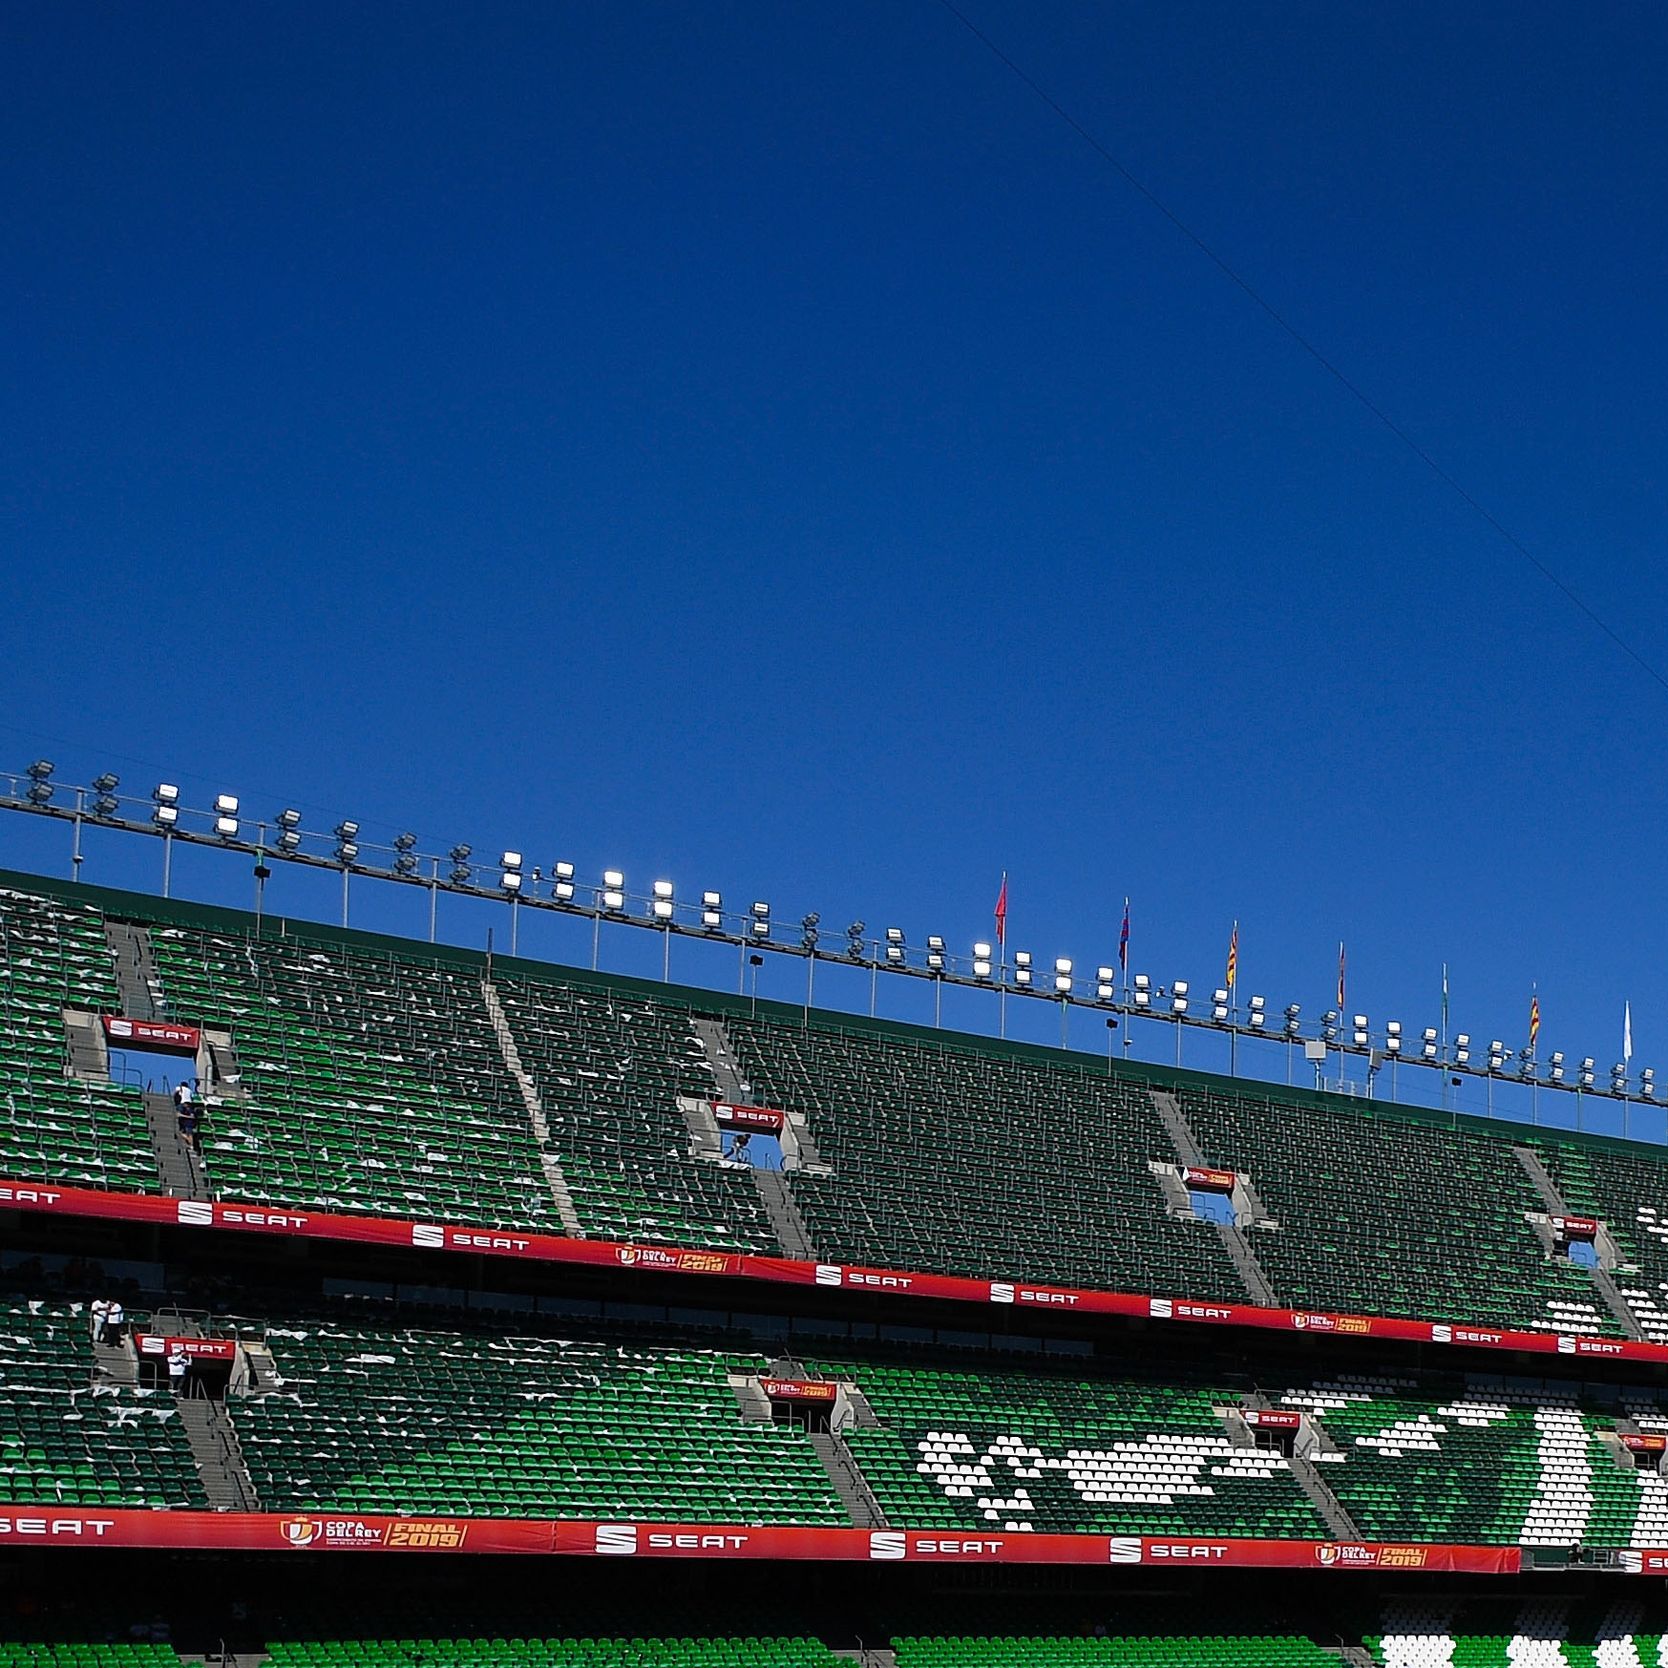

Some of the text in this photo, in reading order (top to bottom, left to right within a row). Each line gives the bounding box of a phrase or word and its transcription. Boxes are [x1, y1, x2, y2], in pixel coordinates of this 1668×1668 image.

[138, 1029, 192, 1041] SEAT
[737, 1111, 778, 1122] SEAT
[0, 1188, 61, 1204] EAT
[223, 1211, 307, 1227] SEAT
[1564, 1221, 1593, 1230] SEAT
[453, 1235, 529, 1250] SEAT
[849, 1274, 912, 1287] SEAT
[1021, 1292, 1078, 1304] SEAT
[1178, 1306, 1231, 1318] SEAT
[1456, 1332, 1502, 1342] SEAT
[170, 1343, 226, 1353] SEAT
[1580, 1343, 1623, 1353] SEAT
[1262, 1416, 1296, 1424] SEAT
[326, 1521, 365, 1530] COPA
[393, 1523, 461, 1534] FINAL
[389, 1532, 460, 1547] 2019
[649, 1535, 748, 1548] SEAT
[917, 1541, 1003, 1553] SEAT
[1151, 1546, 1227, 1557] SEAT
[1382, 1547, 1424, 1556] FINAL
[1380, 1555, 1423, 1566] 2019
